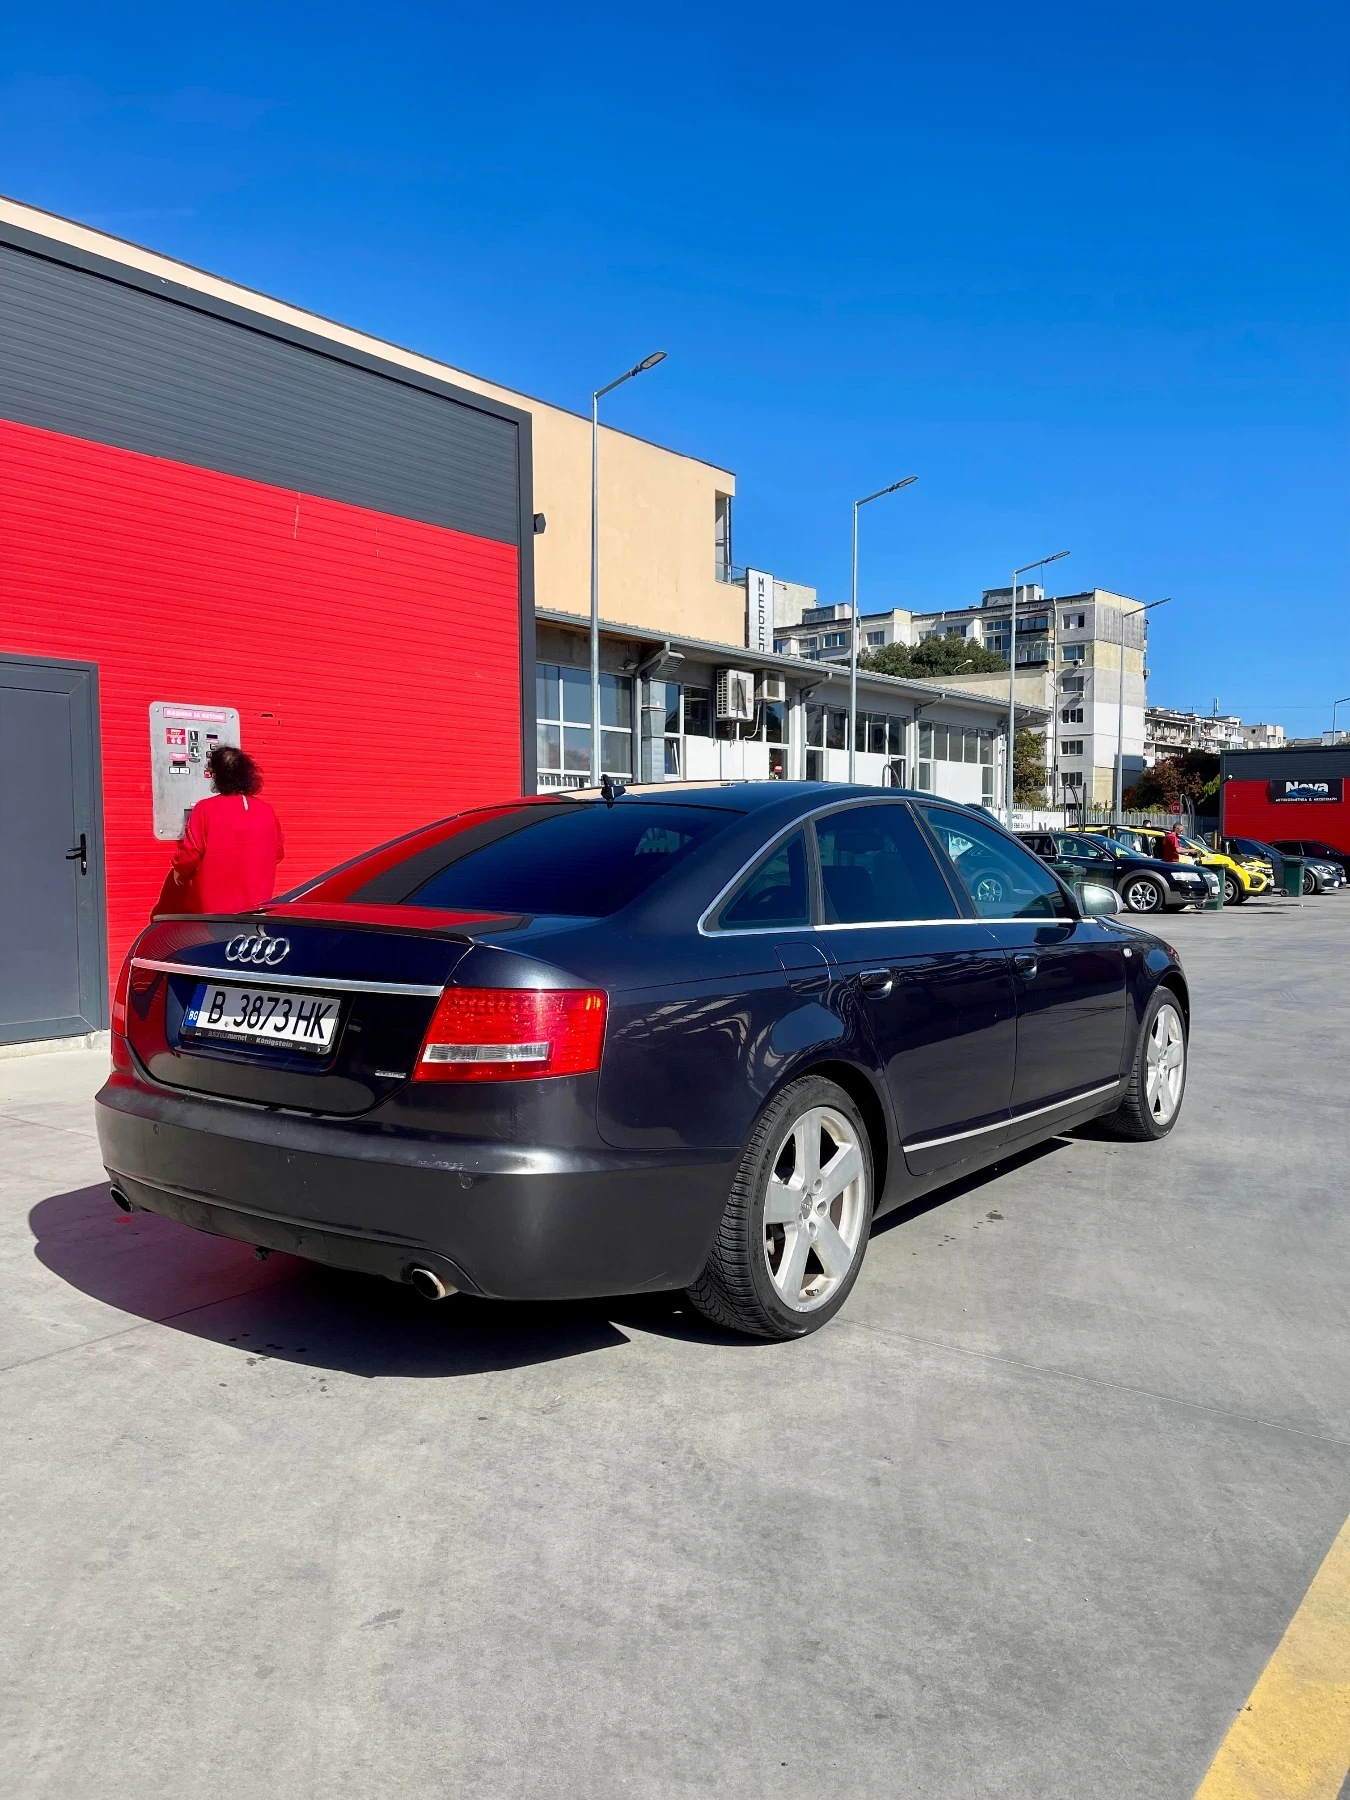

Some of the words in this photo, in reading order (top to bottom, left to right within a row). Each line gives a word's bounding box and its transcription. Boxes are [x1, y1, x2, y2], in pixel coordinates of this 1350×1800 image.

[166, 709, 192, 718] МАШИНА
[188, 1010, 199, 1021] BG
[207, 990, 226, 1024] B
[233, 994, 293, 1033] 3873
[292, 1000, 333, 1039] HK
[255, 1037, 293, 1049] Königstein
[754, 1148, 771, 1206] NEXEN
